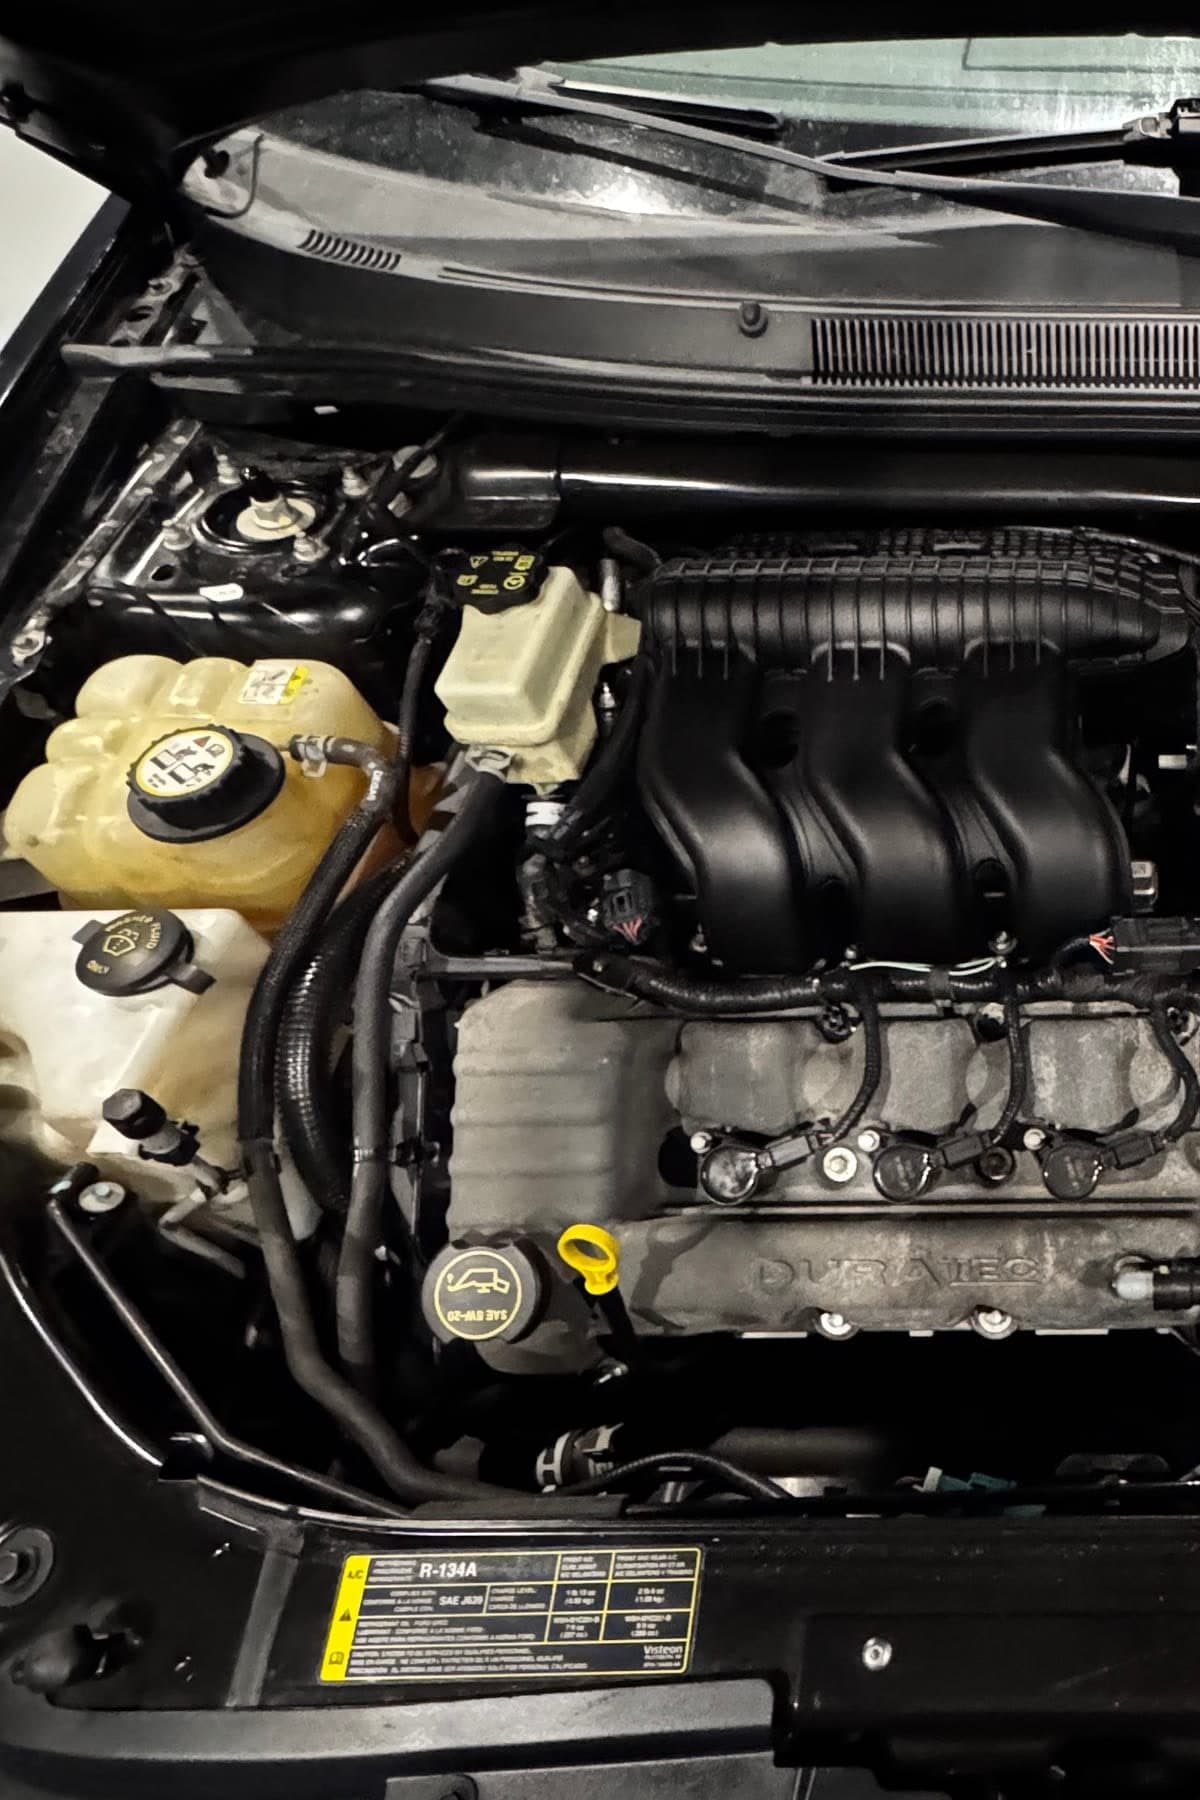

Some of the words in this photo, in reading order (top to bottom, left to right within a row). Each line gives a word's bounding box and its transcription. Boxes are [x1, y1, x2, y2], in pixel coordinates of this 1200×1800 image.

[757, 1256, 1040, 1287] DURATEC
[486, 1309, 508, 1321] SAE
[419, 1562, 477, 1578] R-134A
[439, 1596, 459, 1606] SAE
[643, 1645, 683, 1655] Visteon
